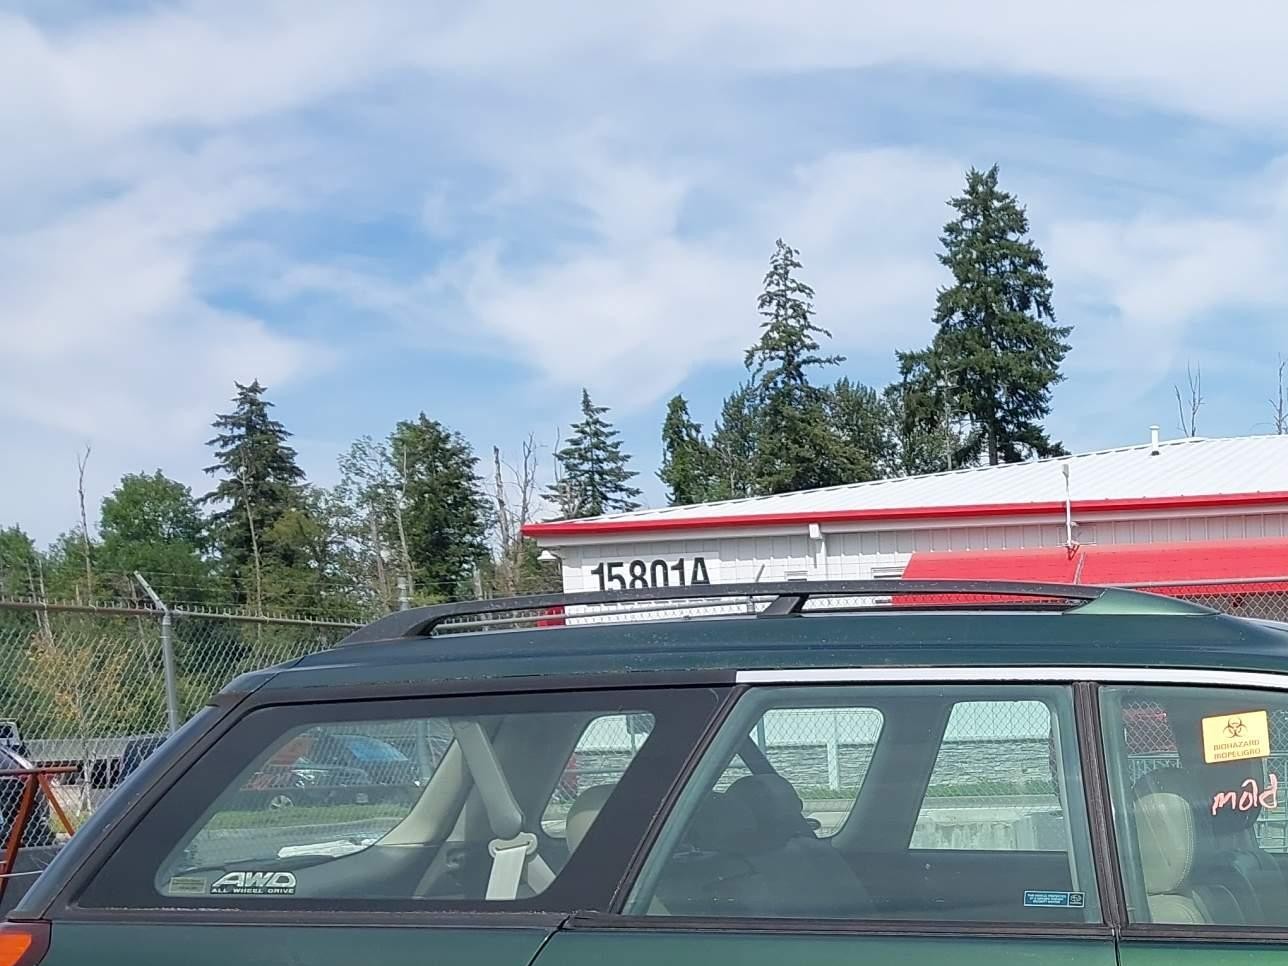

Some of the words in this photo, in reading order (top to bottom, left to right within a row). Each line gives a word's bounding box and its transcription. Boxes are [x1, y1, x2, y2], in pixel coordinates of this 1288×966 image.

[591, 557, 711, 591] 15801A
[1213, 739, 1260, 751] BIOHAZARD
[1212, 773, 1277, 815] mold
[212, 871, 297, 888] AWD
